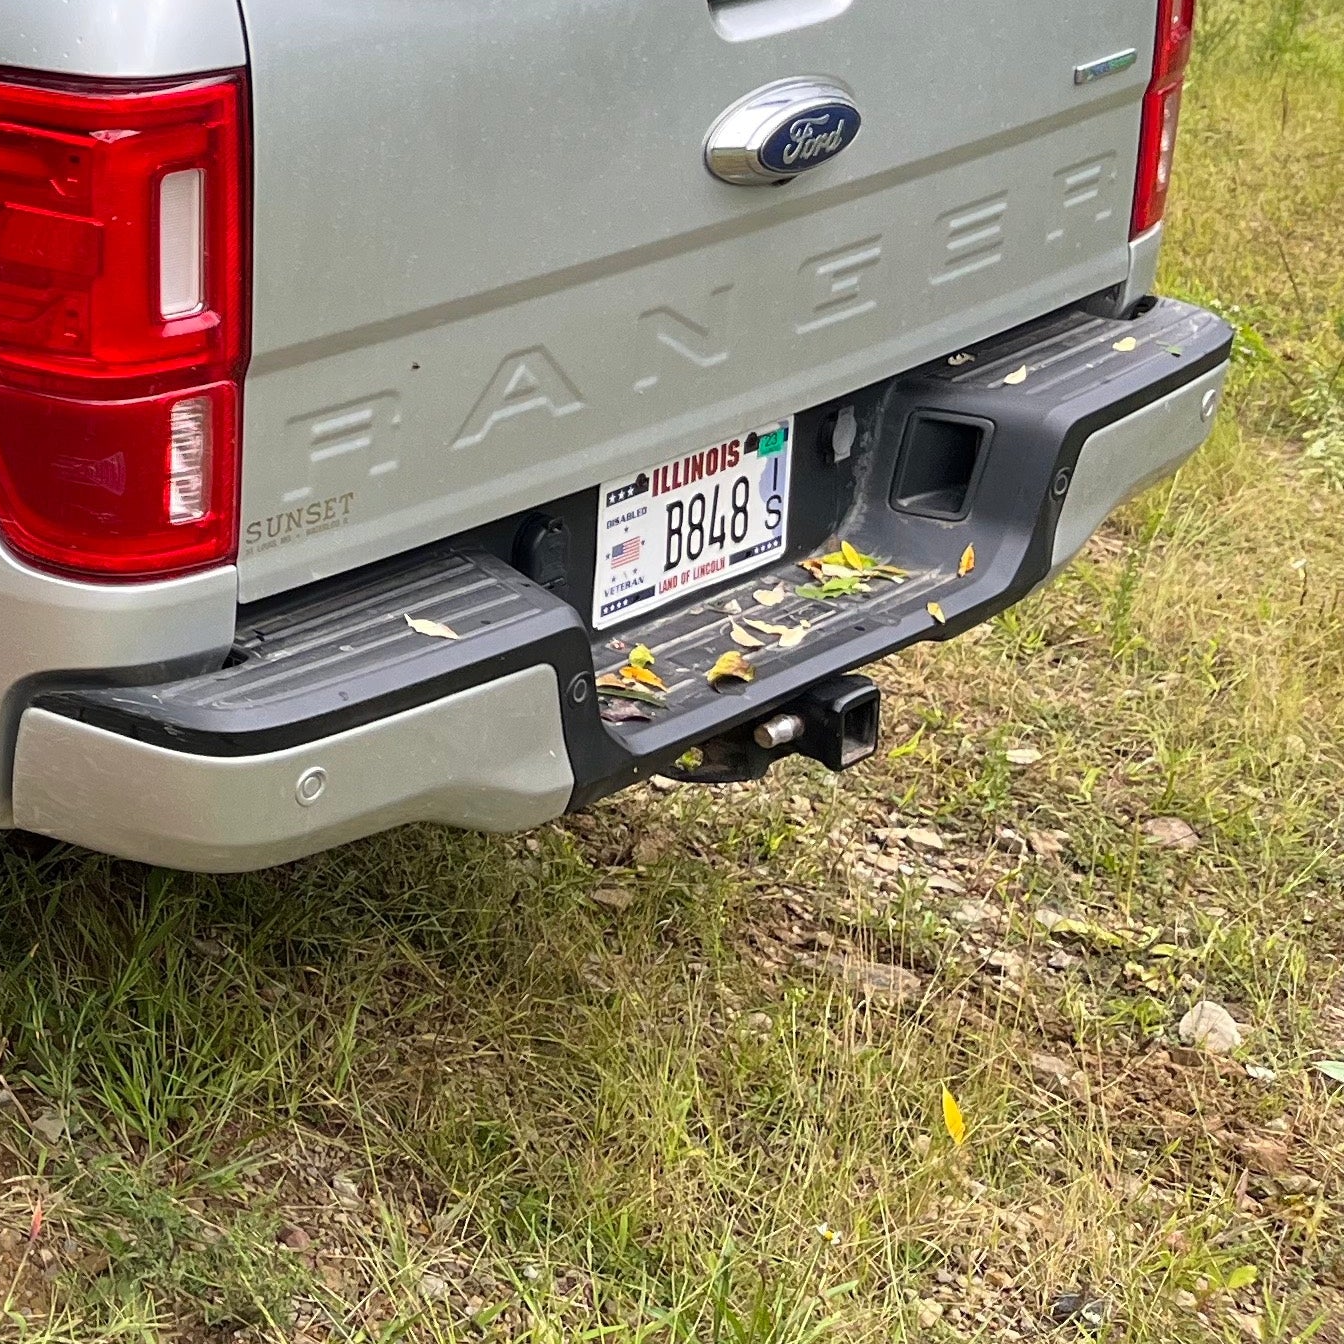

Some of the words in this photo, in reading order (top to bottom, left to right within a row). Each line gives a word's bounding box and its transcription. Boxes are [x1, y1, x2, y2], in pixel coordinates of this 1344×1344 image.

[782, 113, 845, 165] Ford
[283, 149, 1118, 504] RANGER
[764, 432, 778, 447] 23
[651, 439, 741, 497] ILLINOIS
[245, 491, 354, 545] SUNSET
[606, 506, 648, 529] DISABLED
[664, 475, 750, 572] B848
[604, 576, 645, 597] VETERAN
[658, 575, 678, 594] LAND
[680, 569, 691, 585] OF
[693, 556, 726, 581] LINCOLN
